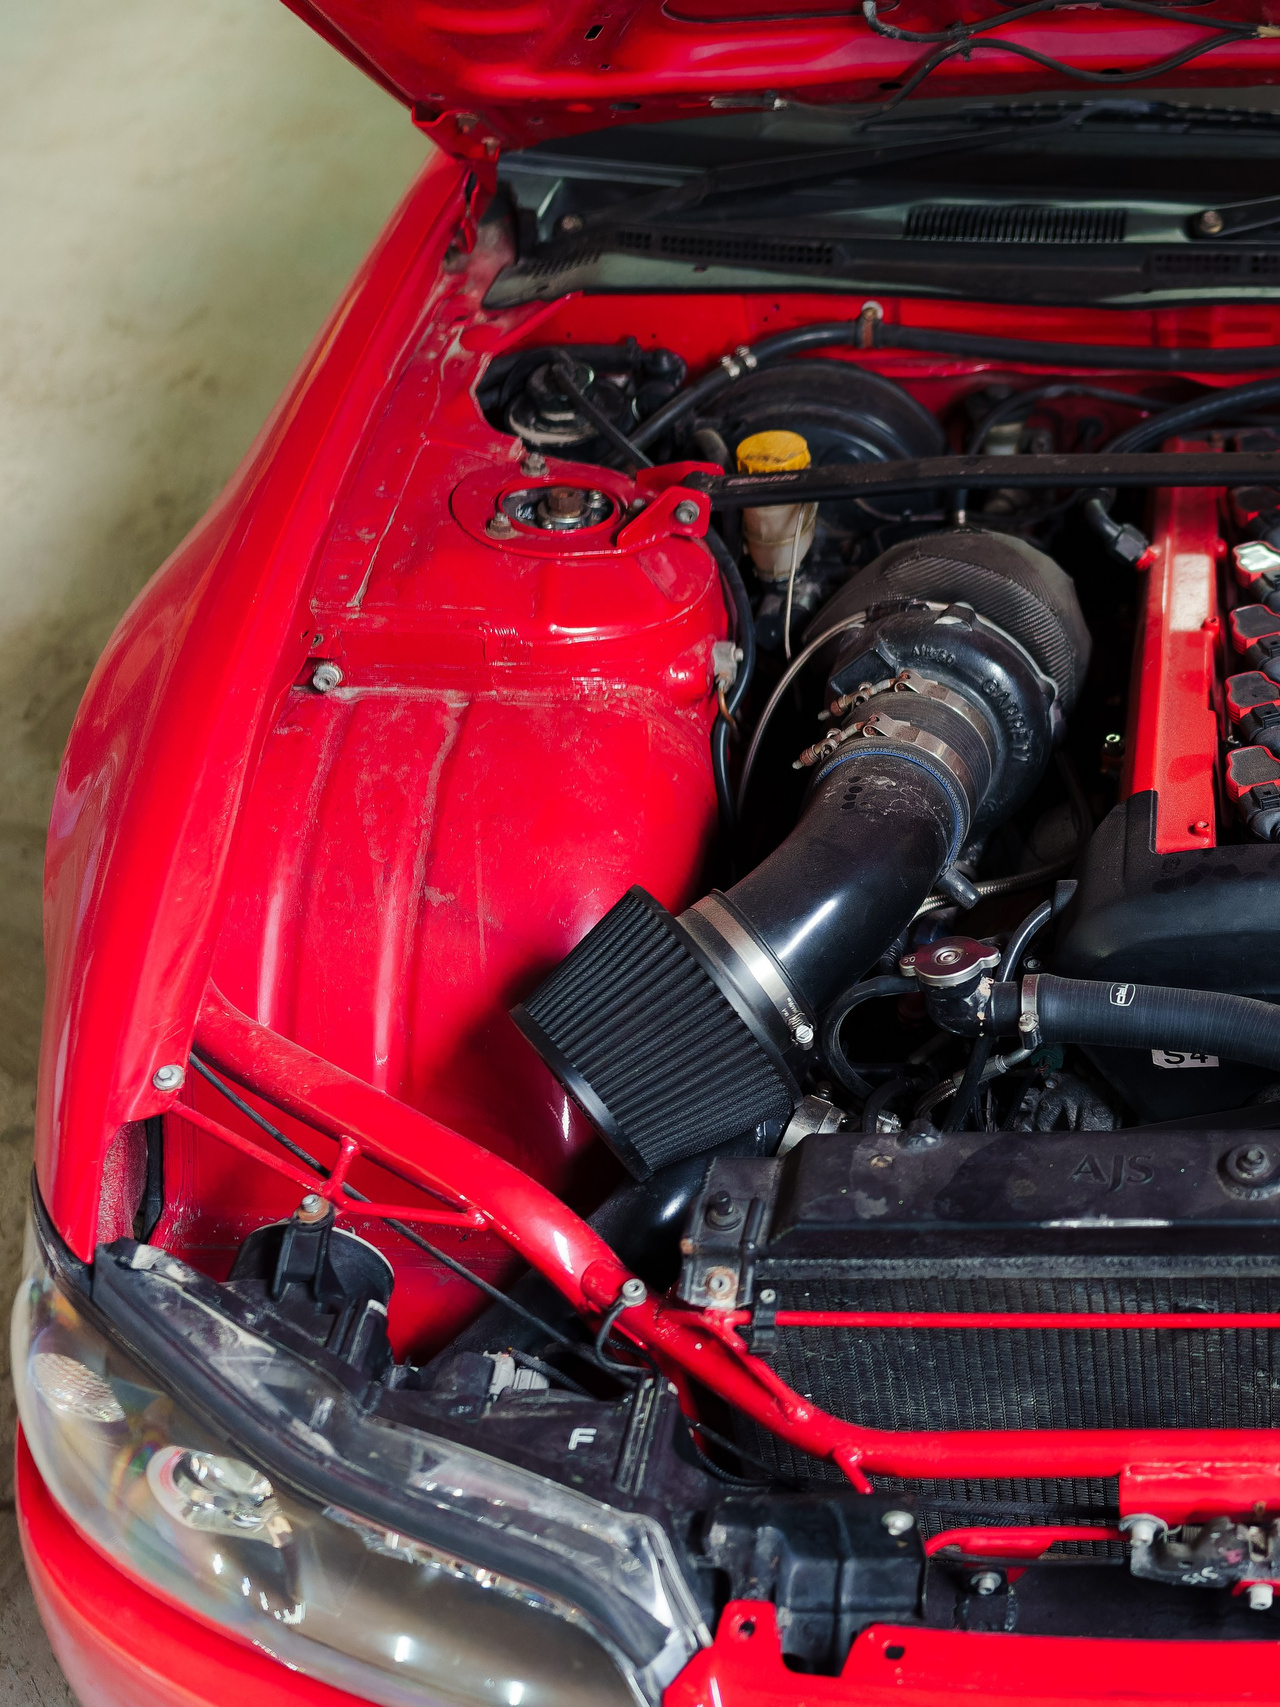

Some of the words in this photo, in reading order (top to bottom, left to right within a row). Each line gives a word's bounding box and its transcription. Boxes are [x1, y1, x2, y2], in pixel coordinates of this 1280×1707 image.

[981, 678, 1034, 763] GARRETT
[1070, 1153, 1156, 1193] AJS
[567, 1427, 598, 1451] F
